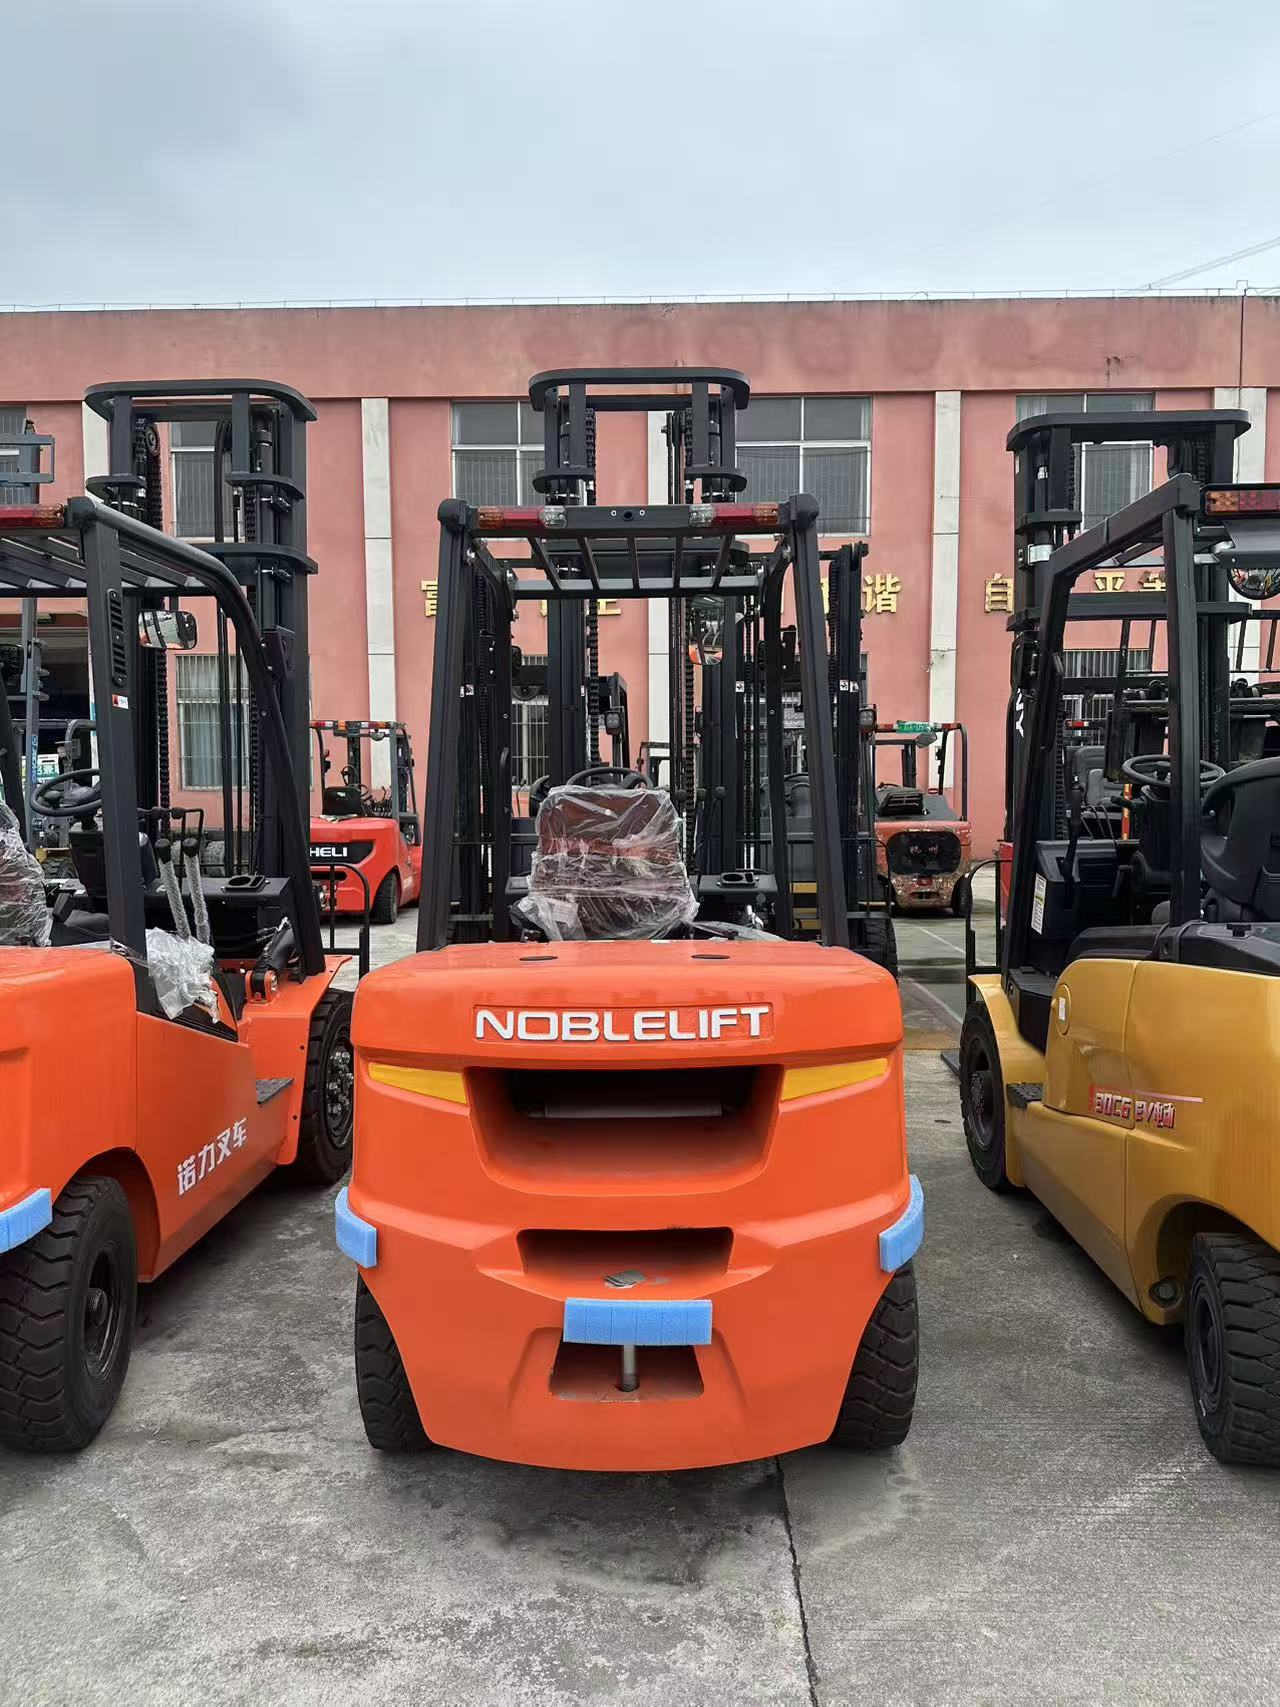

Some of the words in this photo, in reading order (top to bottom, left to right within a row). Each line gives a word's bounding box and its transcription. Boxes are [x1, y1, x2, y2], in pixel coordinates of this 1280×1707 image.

[310, 847, 348, 857] HELI
[475, 1006, 769, 1041] NOBLELIFT
[177, 1117, 247, 1196] 诺力叉车
